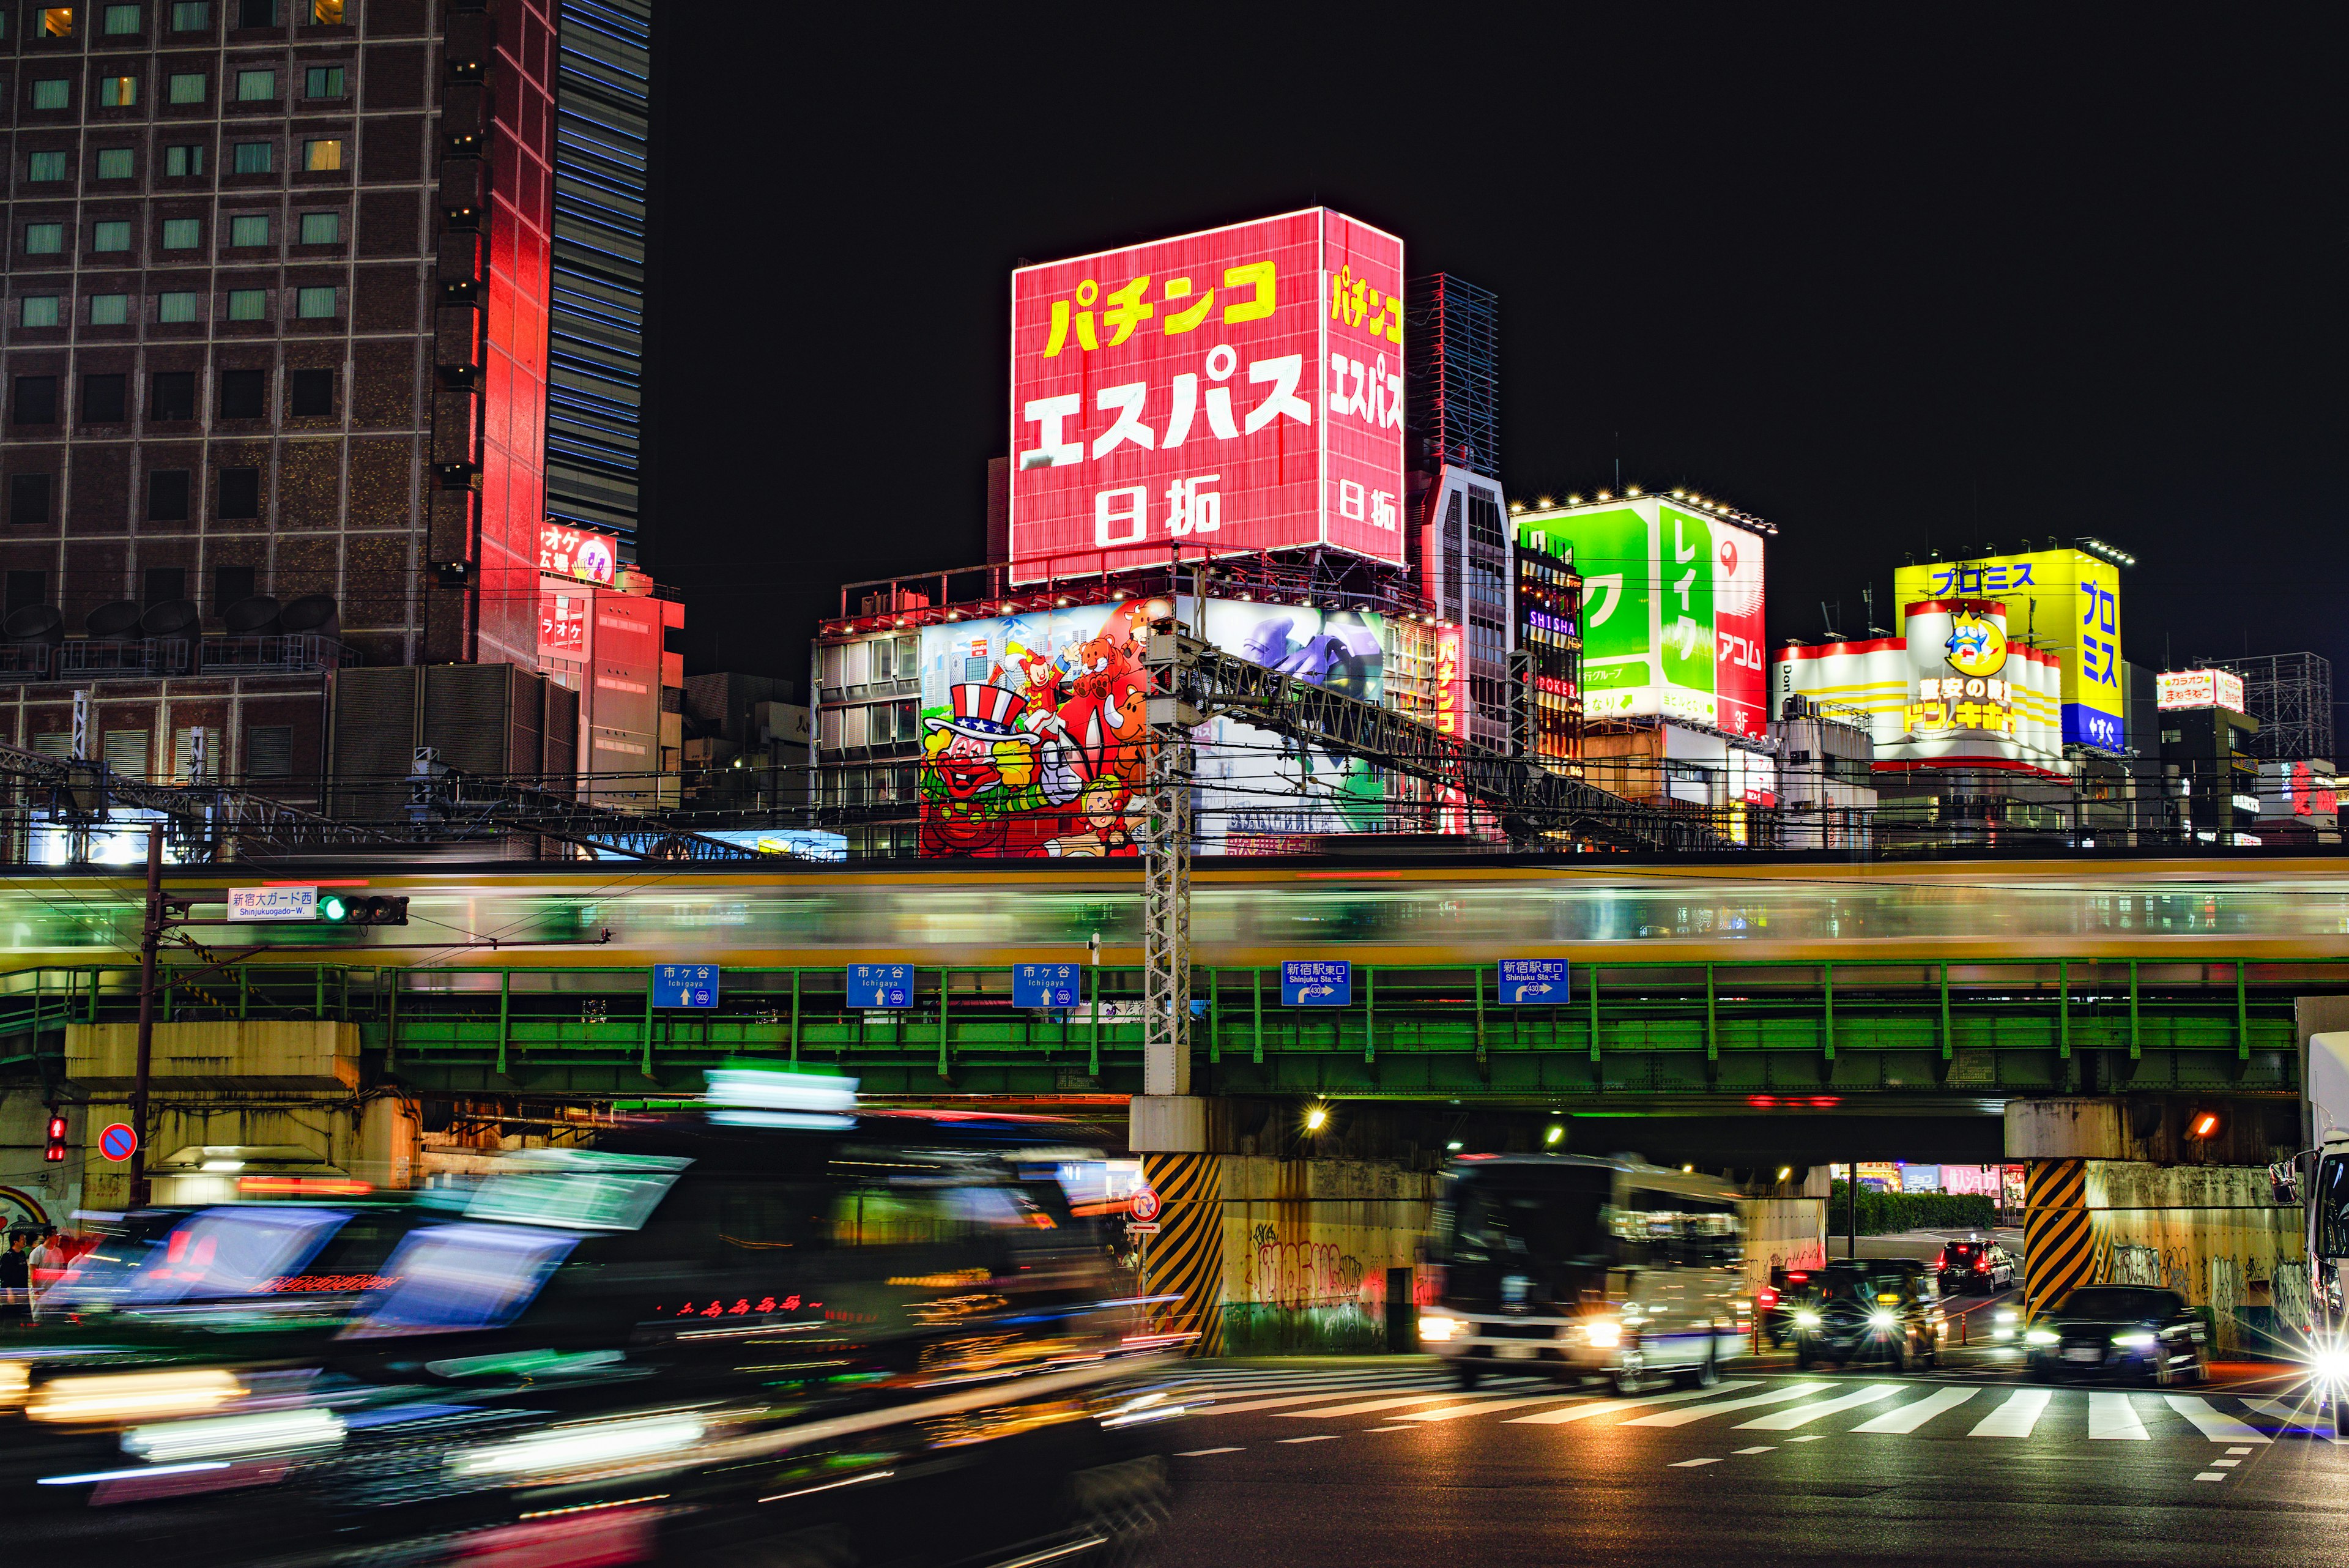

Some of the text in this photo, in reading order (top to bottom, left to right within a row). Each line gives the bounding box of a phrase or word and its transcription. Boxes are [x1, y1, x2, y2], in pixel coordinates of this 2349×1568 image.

[1043, 261, 1276, 358] パチンコ
[1331, 264, 1401, 344] パチンコ
[1330, 352, 1403, 434] エスパス
[1020, 344, 1312, 472] エスパス
[1095, 474, 1221, 548] 日拓
[1339, 478, 1396, 532] 日拓
[1673, 519, 1697, 661] レイク
[1932, 563, 2035, 596] プロミス
[1530, 611, 1575, 636] SHISHA
[1718, 631, 1762, 671] アコム
[1438, 639, 1455, 732] パチンコ
[1783, 665, 1792, 692] Don
[2172, 675, 2204, 686] カラオケ
[2165, 688, 2211, 703] まねきねこ
[1735, 710, 1749, 732] 3F
[2097, 718, 2114, 742] すぐ
[233, 891, 312, 907] 新宿大ガード西
[239, 907, 305, 916] Shinjukuogado-W.
[1286, 963, 1345, 976] 新宿駅東口
[1289, 975, 1318, 984] Shinjuku
[1503, 961, 1563, 973] 新宿駅東口
[1505, 973, 1534, 983] Shinjuku
